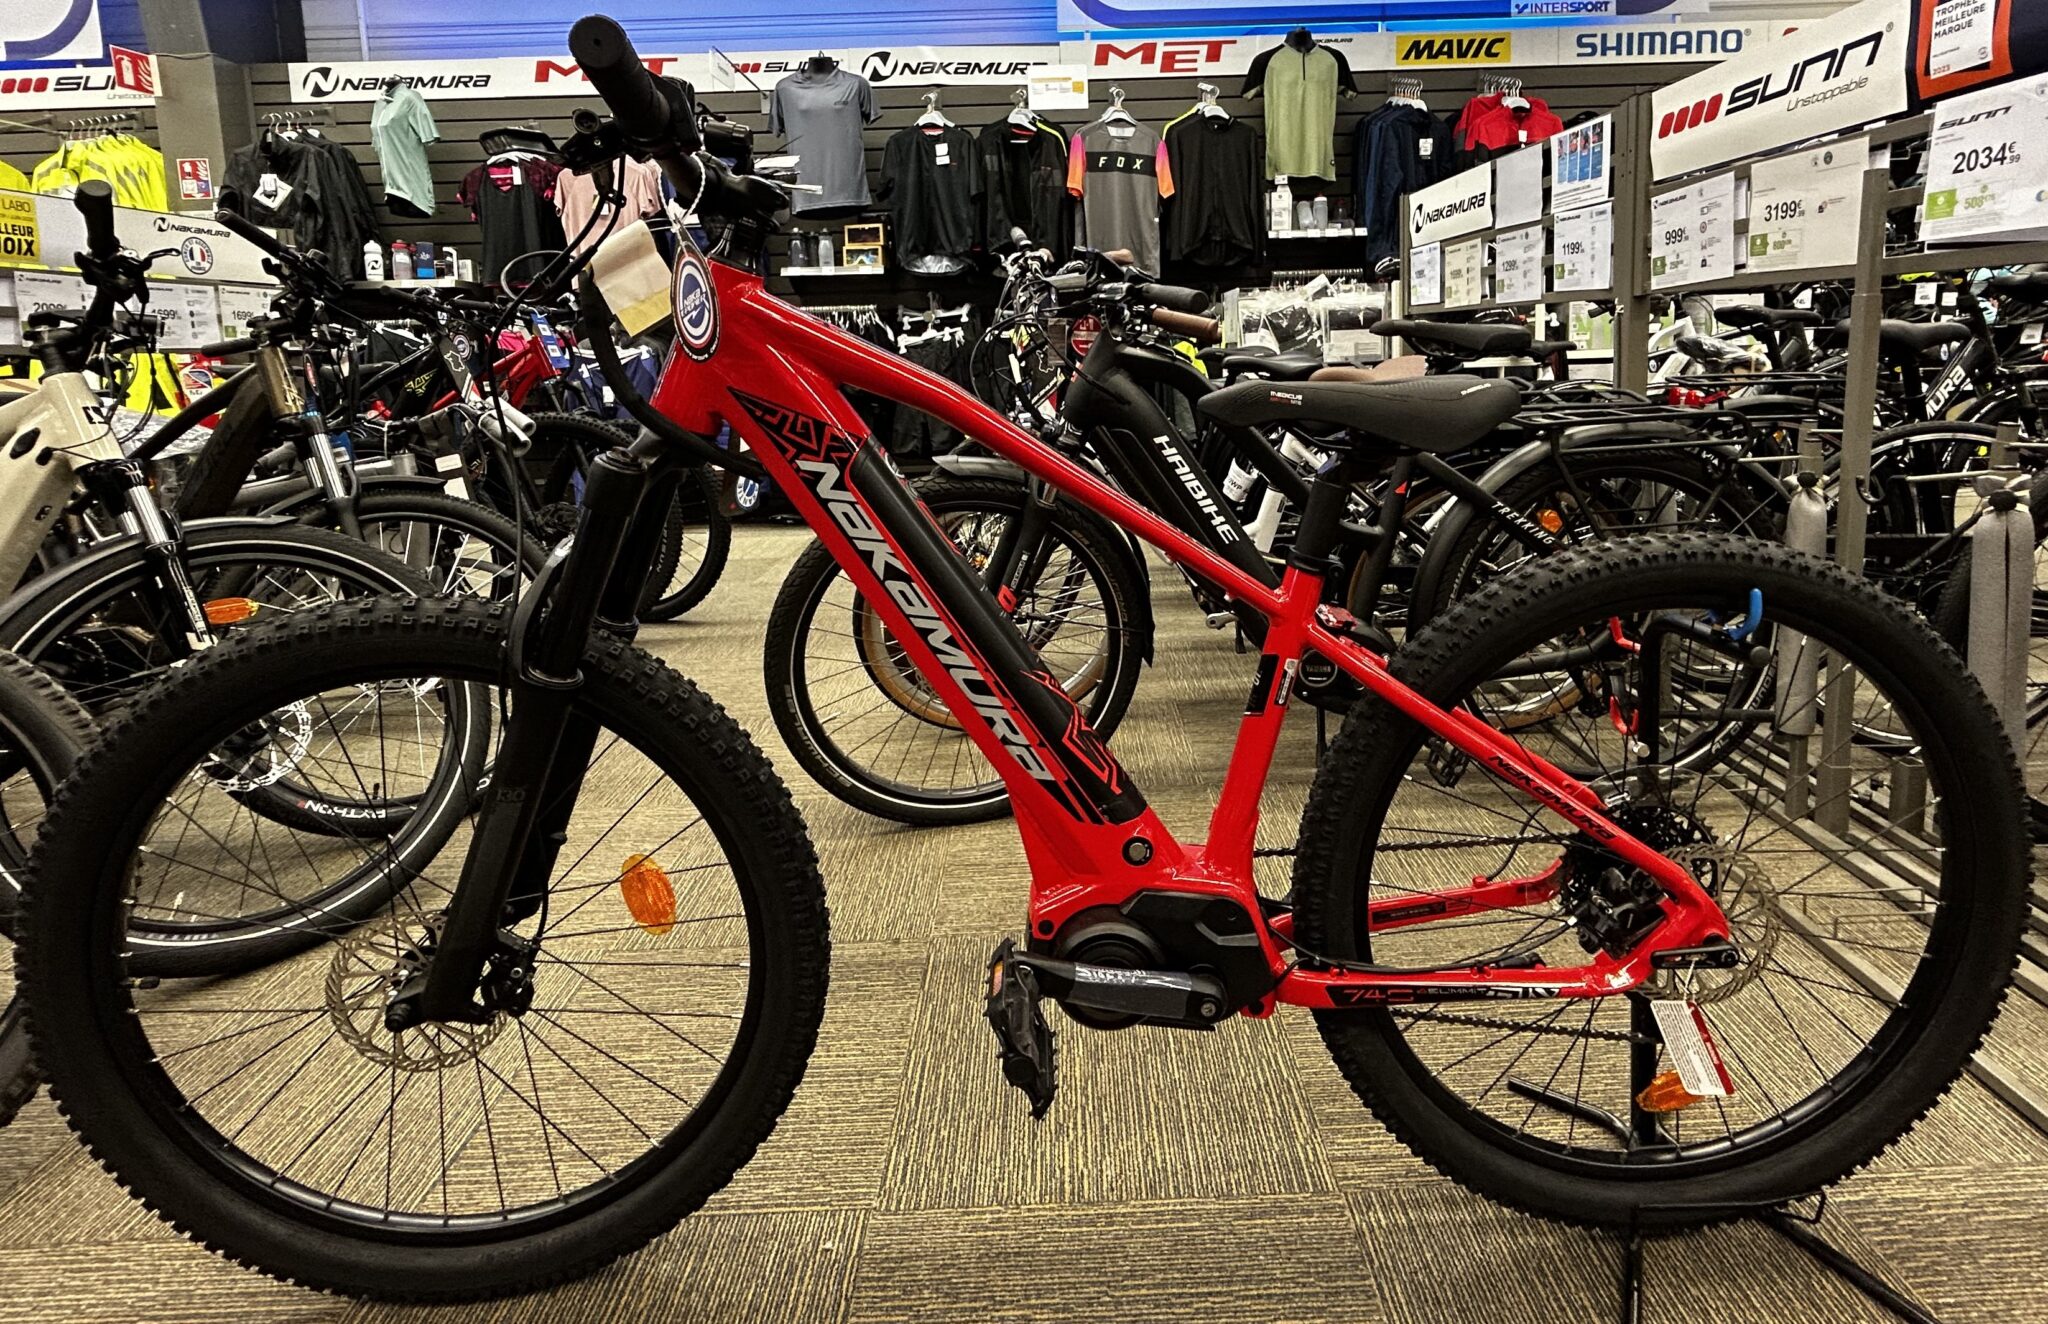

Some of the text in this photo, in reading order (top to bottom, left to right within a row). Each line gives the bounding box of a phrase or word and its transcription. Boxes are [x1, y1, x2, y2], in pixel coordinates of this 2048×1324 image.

[1530, 1, 1610, 14] INTERSPORT
[1934, 3, 1986, 28] MEILLEURE
[1934, 19, 1973, 40] MARQUE
[1402, 37, 1506, 61] MAVIC
[1577, 29, 1743, 57] SHIMANO
[1094, 40, 1238, 73] MET
[535, 57, 678, 83] MT
[1785, 75, 1868, 113] Unstoppable
[1098, 155, 1144, 171] FOX
[1952, 142, 2008, 175] 2034
[1764, 200, 1798, 222] 3199
[1562, 241, 1581, 256] 1199
[1665, 228, 1684, 246] 999
[1490, 500, 1556, 545] TREKKING
